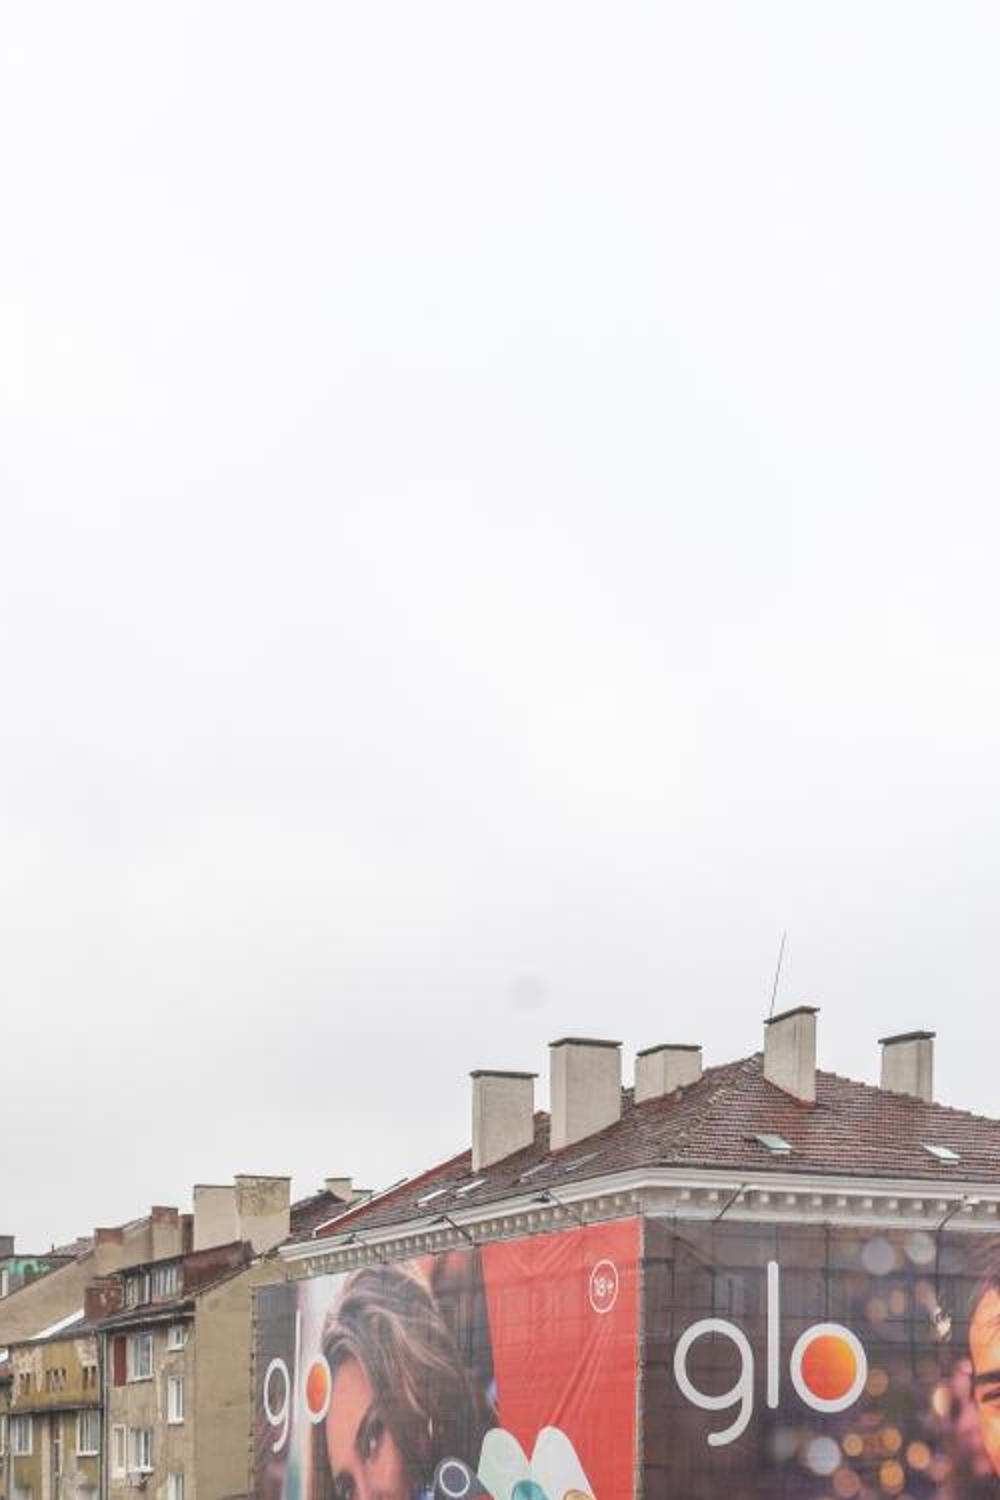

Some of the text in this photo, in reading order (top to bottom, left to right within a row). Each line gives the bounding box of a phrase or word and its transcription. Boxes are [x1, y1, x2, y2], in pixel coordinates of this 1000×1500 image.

[593, 1277, 614, 1296] 18+
[673, 1261, 868, 1447] glo
[263, 1310, 332, 1454] glo
